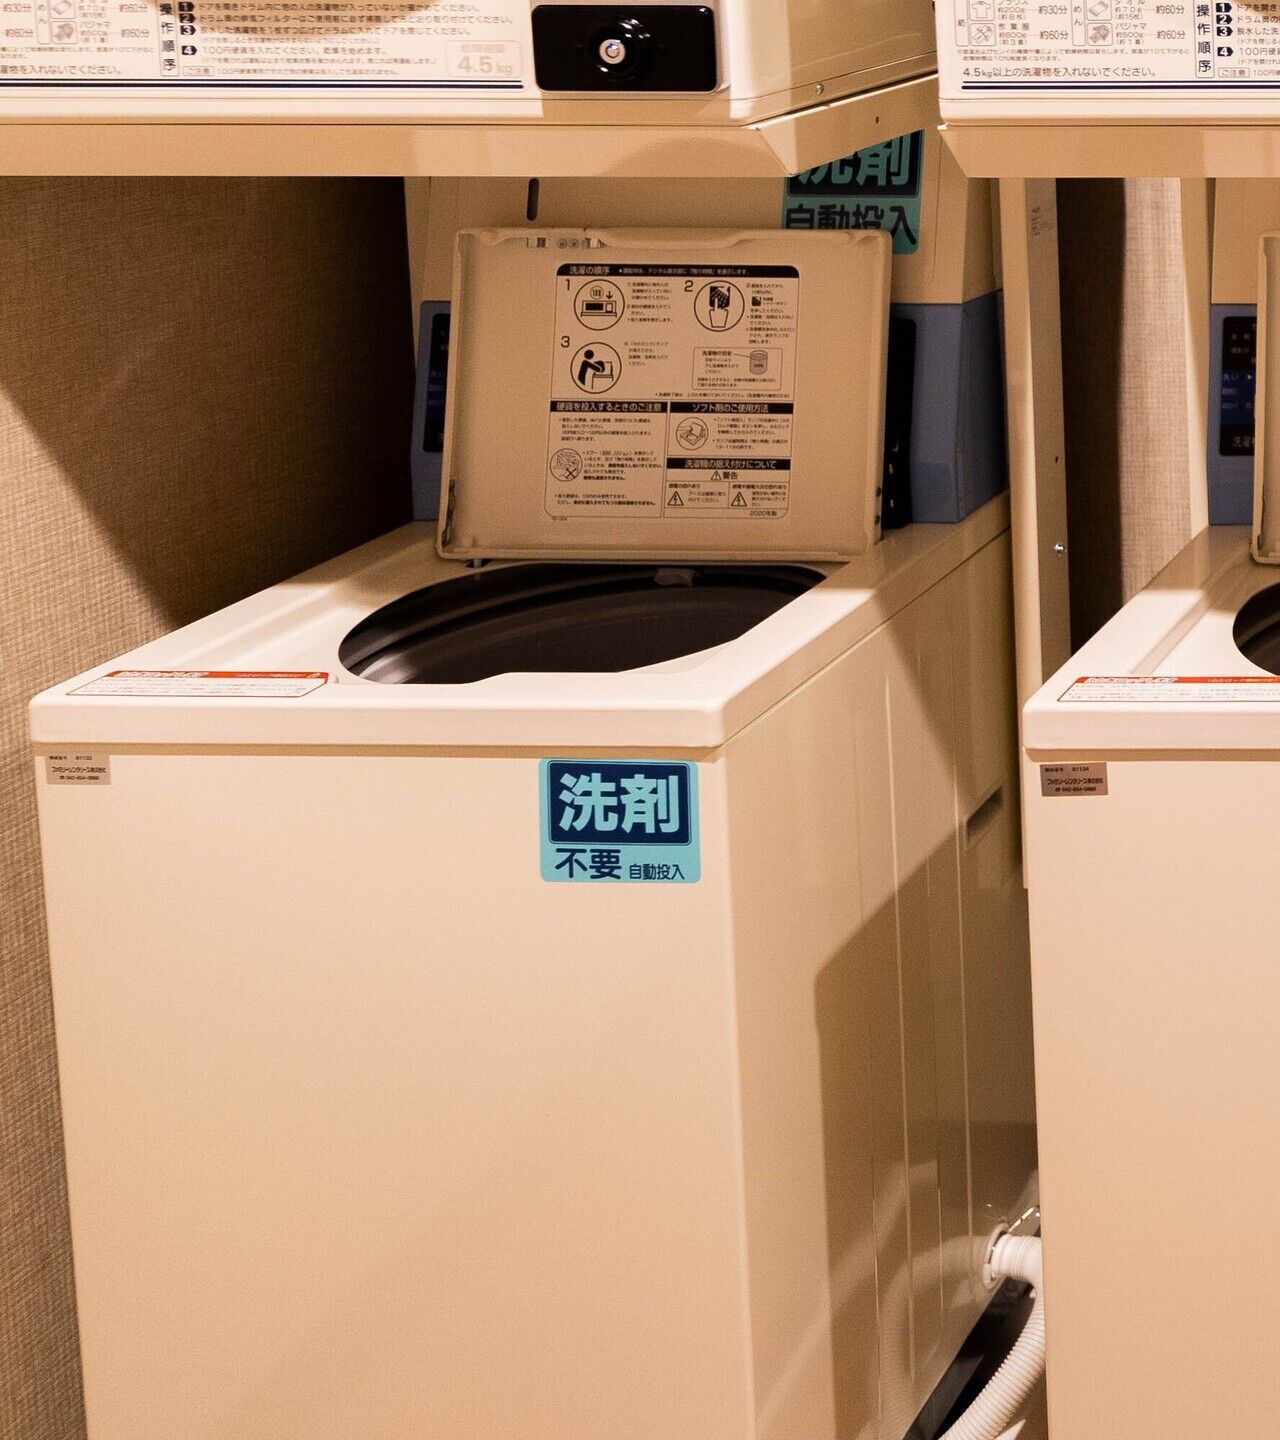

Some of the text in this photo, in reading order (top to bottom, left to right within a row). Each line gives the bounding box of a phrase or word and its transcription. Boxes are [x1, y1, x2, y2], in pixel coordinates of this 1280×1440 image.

[1196, 4, 1211, 73] 操作順序
[786, 204, 917, 245] 自動投入
[683, 280, 693, 292] 2
[560, 336, 570, 348] 3
[559, 773, 680, 834] 洗剤
[555, 848, 685, 880] 不要 自動投入
